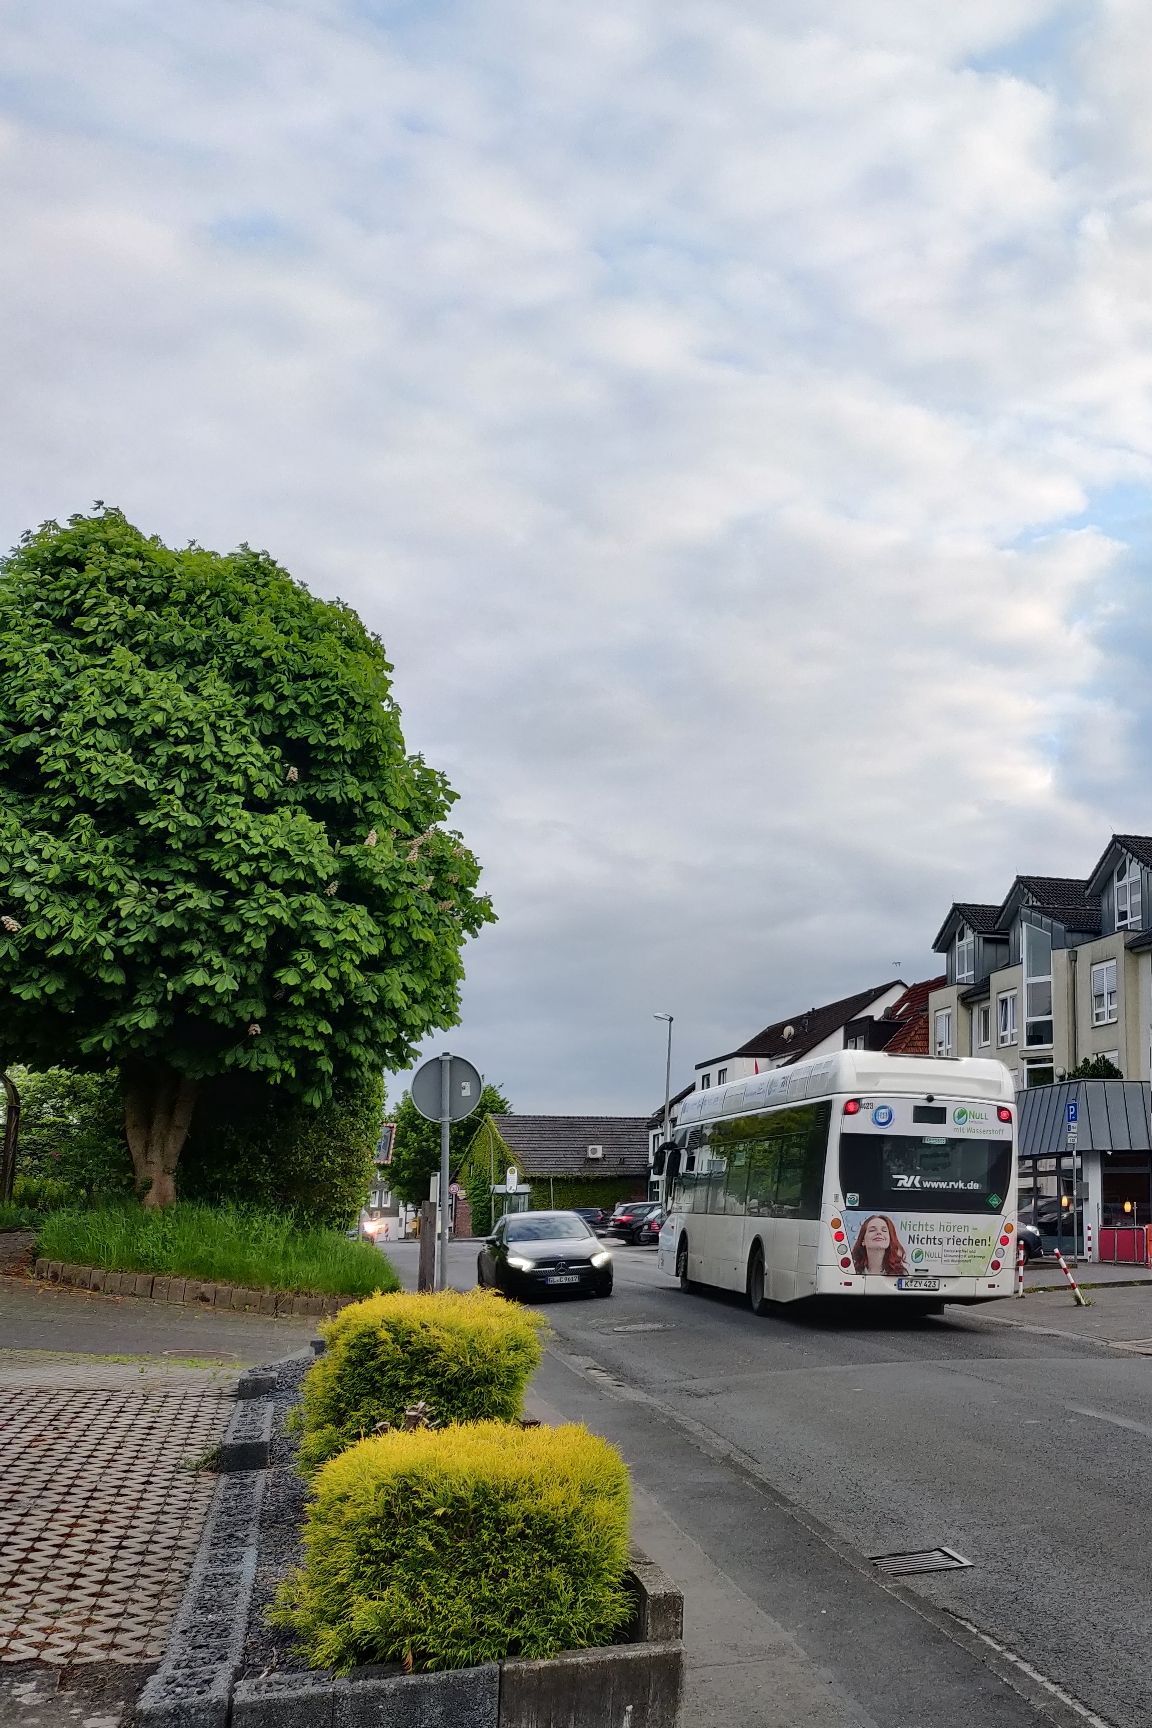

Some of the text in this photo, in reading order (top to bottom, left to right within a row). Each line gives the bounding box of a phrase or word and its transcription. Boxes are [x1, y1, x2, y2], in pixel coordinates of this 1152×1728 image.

[966, 1126, 1005, 1135] Wasserstoff
[922, 1180, 980, 1190] www.rvk.de
[900, 1221, 935, 1232] Nichts
[938, 1221, 970, 1233] hören
[907, 1234, 991, 1247] Nichts riechen!
